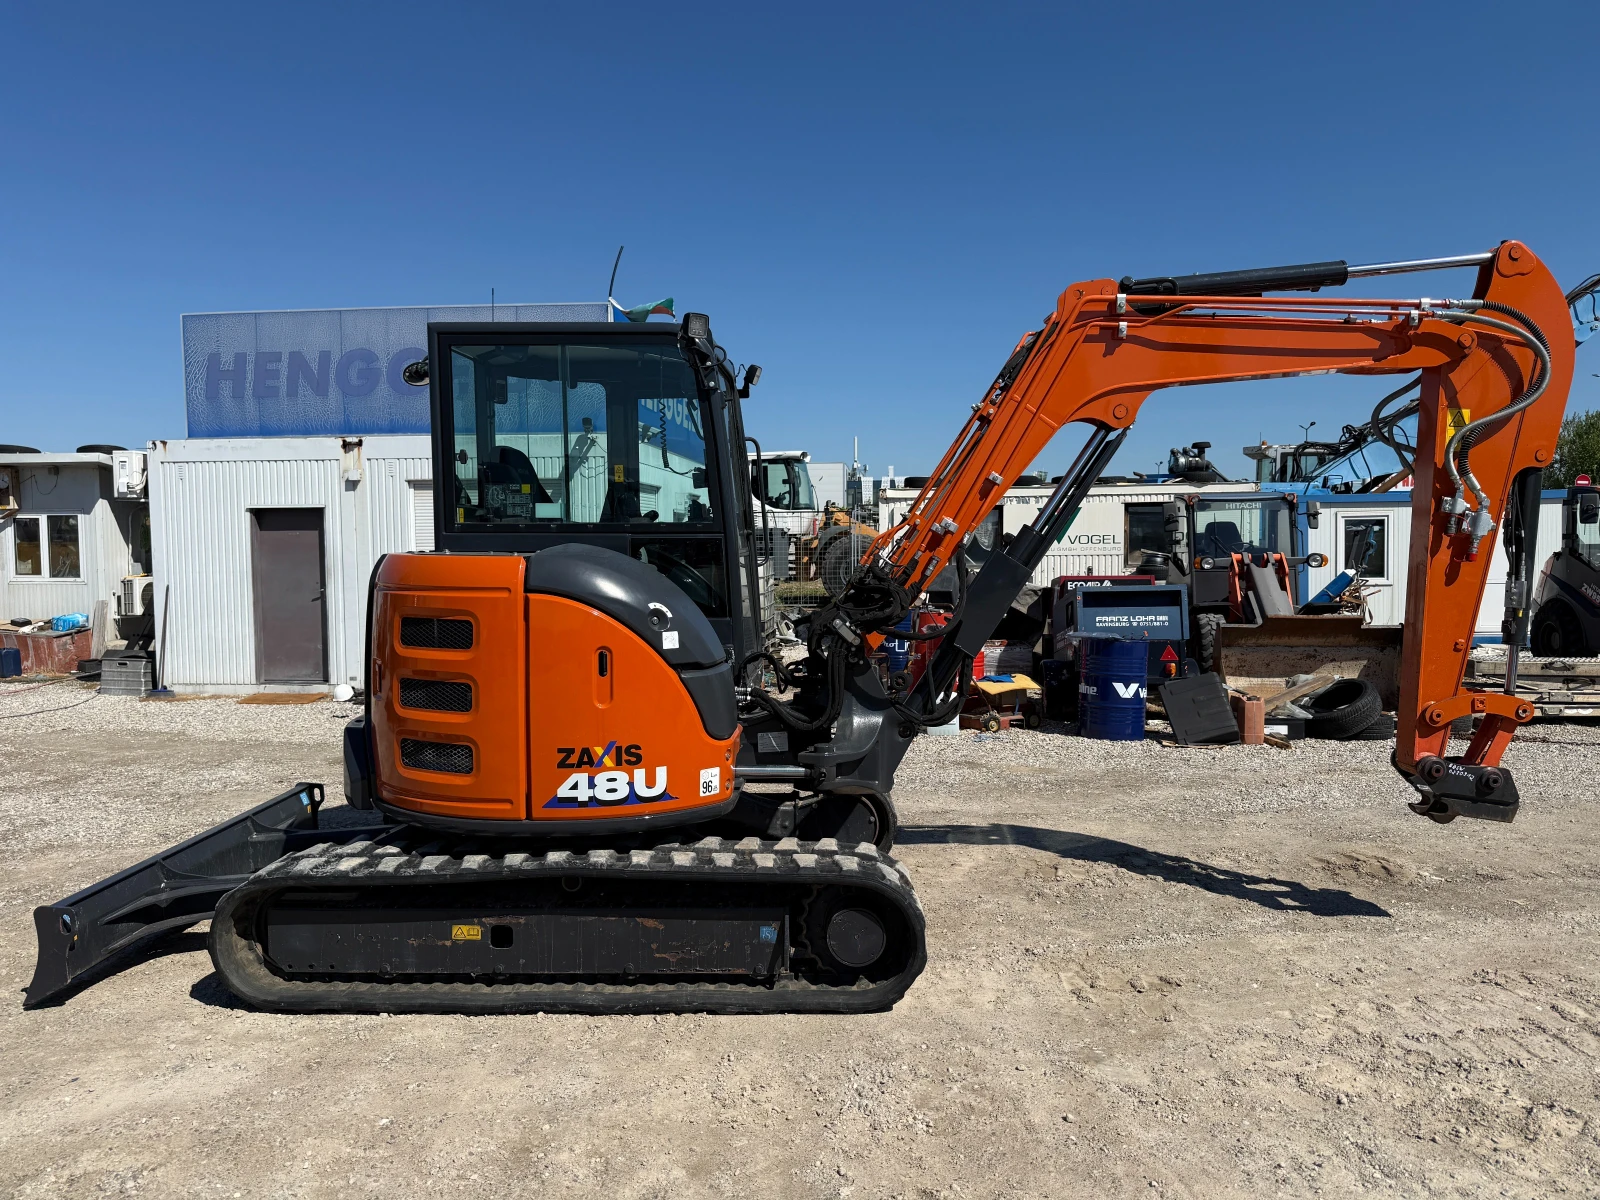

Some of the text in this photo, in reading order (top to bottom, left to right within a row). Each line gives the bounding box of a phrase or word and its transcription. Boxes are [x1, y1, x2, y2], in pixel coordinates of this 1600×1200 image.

[1225, 502, 1262, 510] HITACHI
[1067, 534, 1122, 545] VOGEL
[556, 740, 643, 769] ZAXIS
[556, 765, 668, 805] 48U
[702, 780, 713, 794] 96
